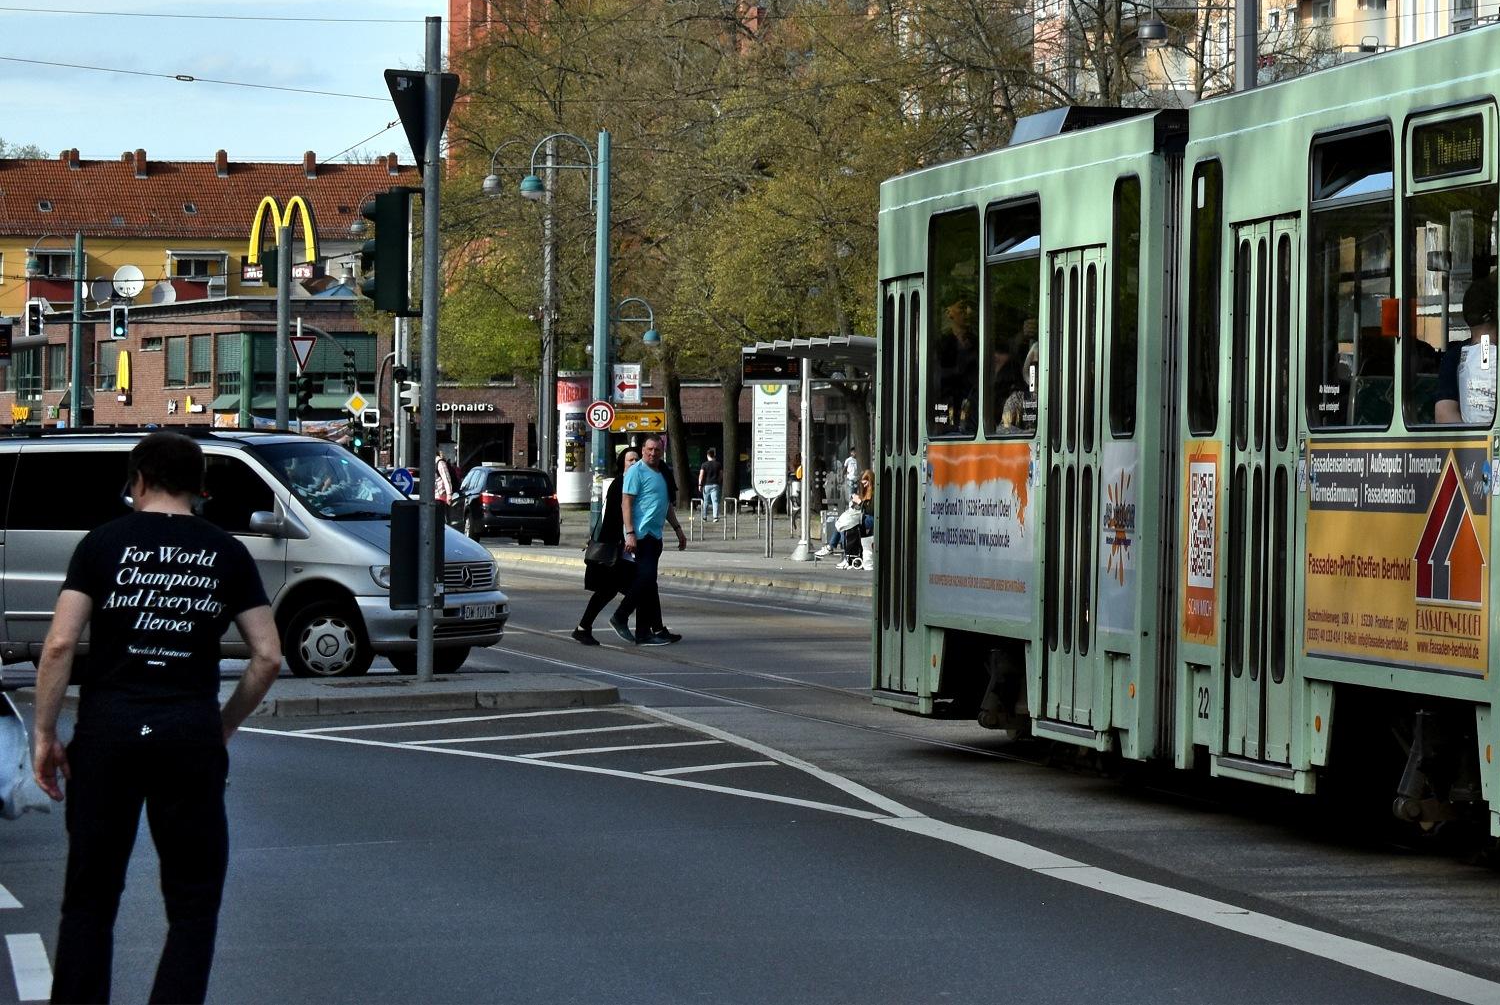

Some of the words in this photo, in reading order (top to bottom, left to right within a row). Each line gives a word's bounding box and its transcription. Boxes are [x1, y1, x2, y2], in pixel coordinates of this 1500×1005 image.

[1437, 127, 1481, 165] Markendor
[245, 267, 311, 279] Mcld's
[435, 402, 494, 412] cDonald's
[593, 409, 609, 422] 50
[1310, 453, 1365, 477] Fassadensanierung
[1370, 453, 1402, 478] Außenputz
[1408, 453, 1442, 478] Innenputz
[1310, 483, 1358, 507] Wärmedämmung
[1364, 483, 1416, 505] Fassadenanstrich
[930, 498, 945, 520] Langer
[945, 498, 957, 515] Grund
[957, 499, 963, 515] 70
[978, 498, 998, 517] Frankfurt
[997, 498, 1012, 521] (Oder)
[120, 546, 155, 564] For
[159, 546, 218, 568] World
[1308, 552, 1356, 577] Fassaden-Profi
[1356, 555, 1381, 578] Steffen
[1381, 556, 1411, 581] Berthold
[116, 566, 220, 591] Champions
[102, 588, 144, 610] And
[143, 589, 227, 618] Everyday
[1187, 598, 1201, 615] SCAN
[1200, 599, 1213, 617] MICH
[132, 611, 196, 633] Heroes
[1307, 608, 1340, 627] Buschmühlenweg
[1350, 613, 1354, 626] A
[1360, 612, 1374, 628] 15230
[1374, 614, 1394, 630] Frankfurt
[1395, 616, 1410, 634] (Oder)
[1415, 609, 1481, 636] FASSADEN-PROFI
[128, 644, 158, 656] Swedish
[157, 646, 194, 658] Footwear
[1416, 638, 1480, 660] www.fassaden-berthold.de
